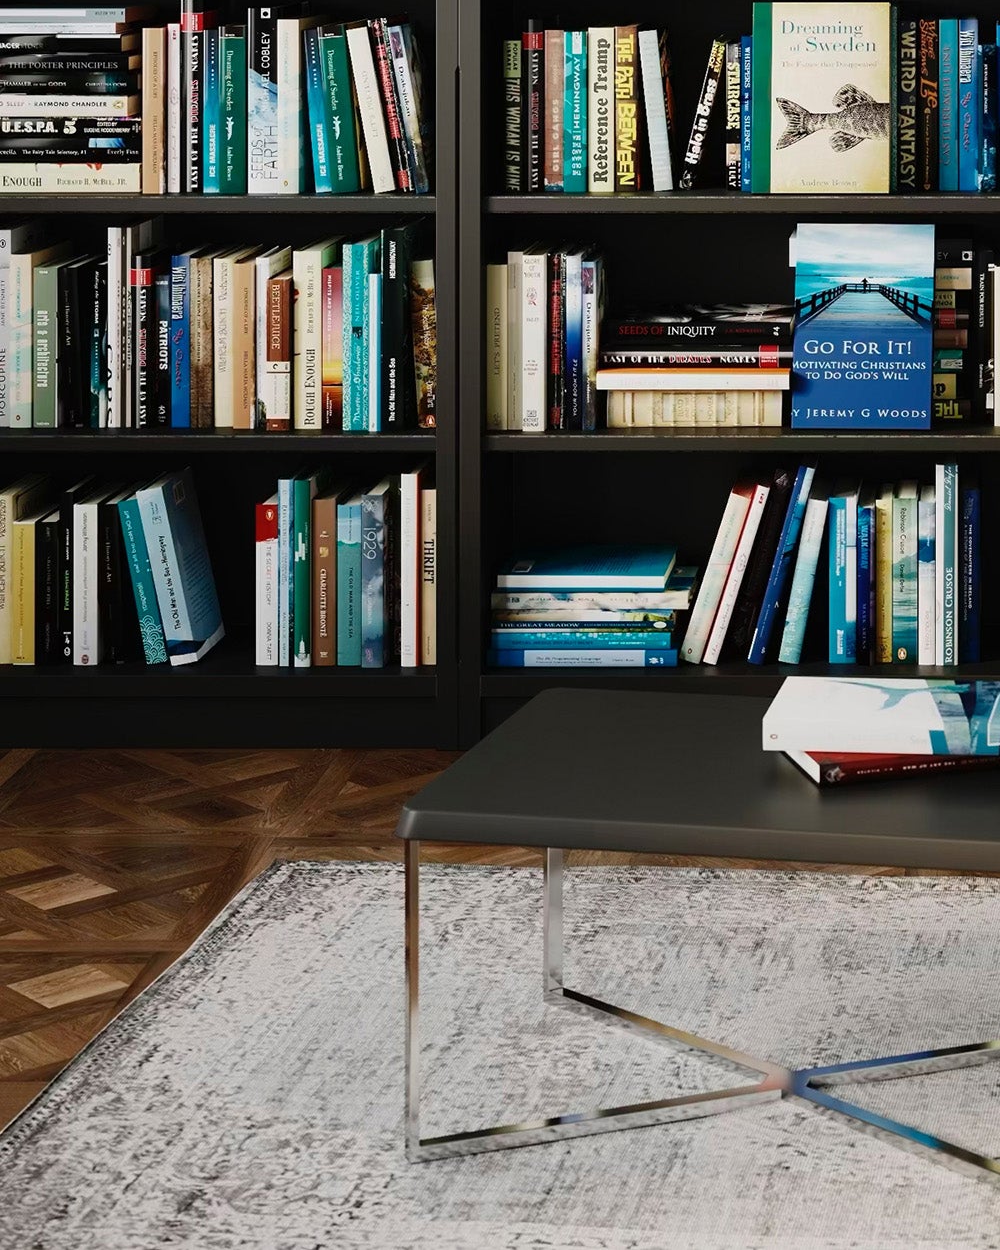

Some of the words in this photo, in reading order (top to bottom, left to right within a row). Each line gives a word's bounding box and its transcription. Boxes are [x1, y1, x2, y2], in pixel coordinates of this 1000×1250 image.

[782, 20, 864, 37] Dreaming
[790, 43, 802, 52] of
[806, 36, 877, 52] Sweden
[615, 35, 637, 63] THE
[902, 31, 915, 92] WEIRD
[225, 50, 234, 80] Dreaming
[594, 38, 611, 94] Tramp
[506, 78, 520, 102] THIS
[573, 57, 581, 129] HEMINGWAY
[615, 66, 637, 99] PATH
[727, 62, 741, 130] STAIRCASE
[920, 77, 938, 108] Lie
[225, 88, 234, 111] Sweden
[2, 121, 58, 133] U.E.S.P.A.
[63, 120, 77, 134] 5
[506, 107, 520, 146] WOMAN
[594, 98, 611, 183] Reference
[506, 150, 520, 162] IS
[615, 103, 637, 186] BETWEEN
[902, 105, 915, 188] FANTASY
[506, 165, 520, 191] MINE
[271, 284, 280, 349] BEETLEJUICE
[618, 326, 648, 335] SEEDS
[650, 326, 664, 335] OF
[667, 326, 716, 337] INIQUITY
[159, 320, 168, 370] PATRIOTS
[804, 340, 835, 355] GO
[843, 340, 881, 355] FOR
[887, 340, 912, 355] IT!
[304, 349, 316, 389] ENOUGH
[793, 361, 858, 370] MOTIVATING
[860, 360, 927, 371] CHRISTIANS
[806, 372, 819, 381] TO
[824, 372, 842, 381] DO
[845, 371, 879, 381] GOD'S
[883, 371, 910, 381] WILL
[304, 392, 316, 426] ROUGH
[791, 408, 801, 418] Y
[806, 408, 855, 419] JEREMY
[861, 408, 872, 418] G
[878, 408, 928, 418] WOODS
[935, 401, 964, 419] THE
[899, 507, 907, 533] Robinson
[363, 527, 376, 559] 1929
[899, 534, 907, 555] Crusoe
[423, 539, 435, 584] THRIFT
[945, 567, 953, 608] CRUSOE
[945, 610, 953, 663] ROBINSON
